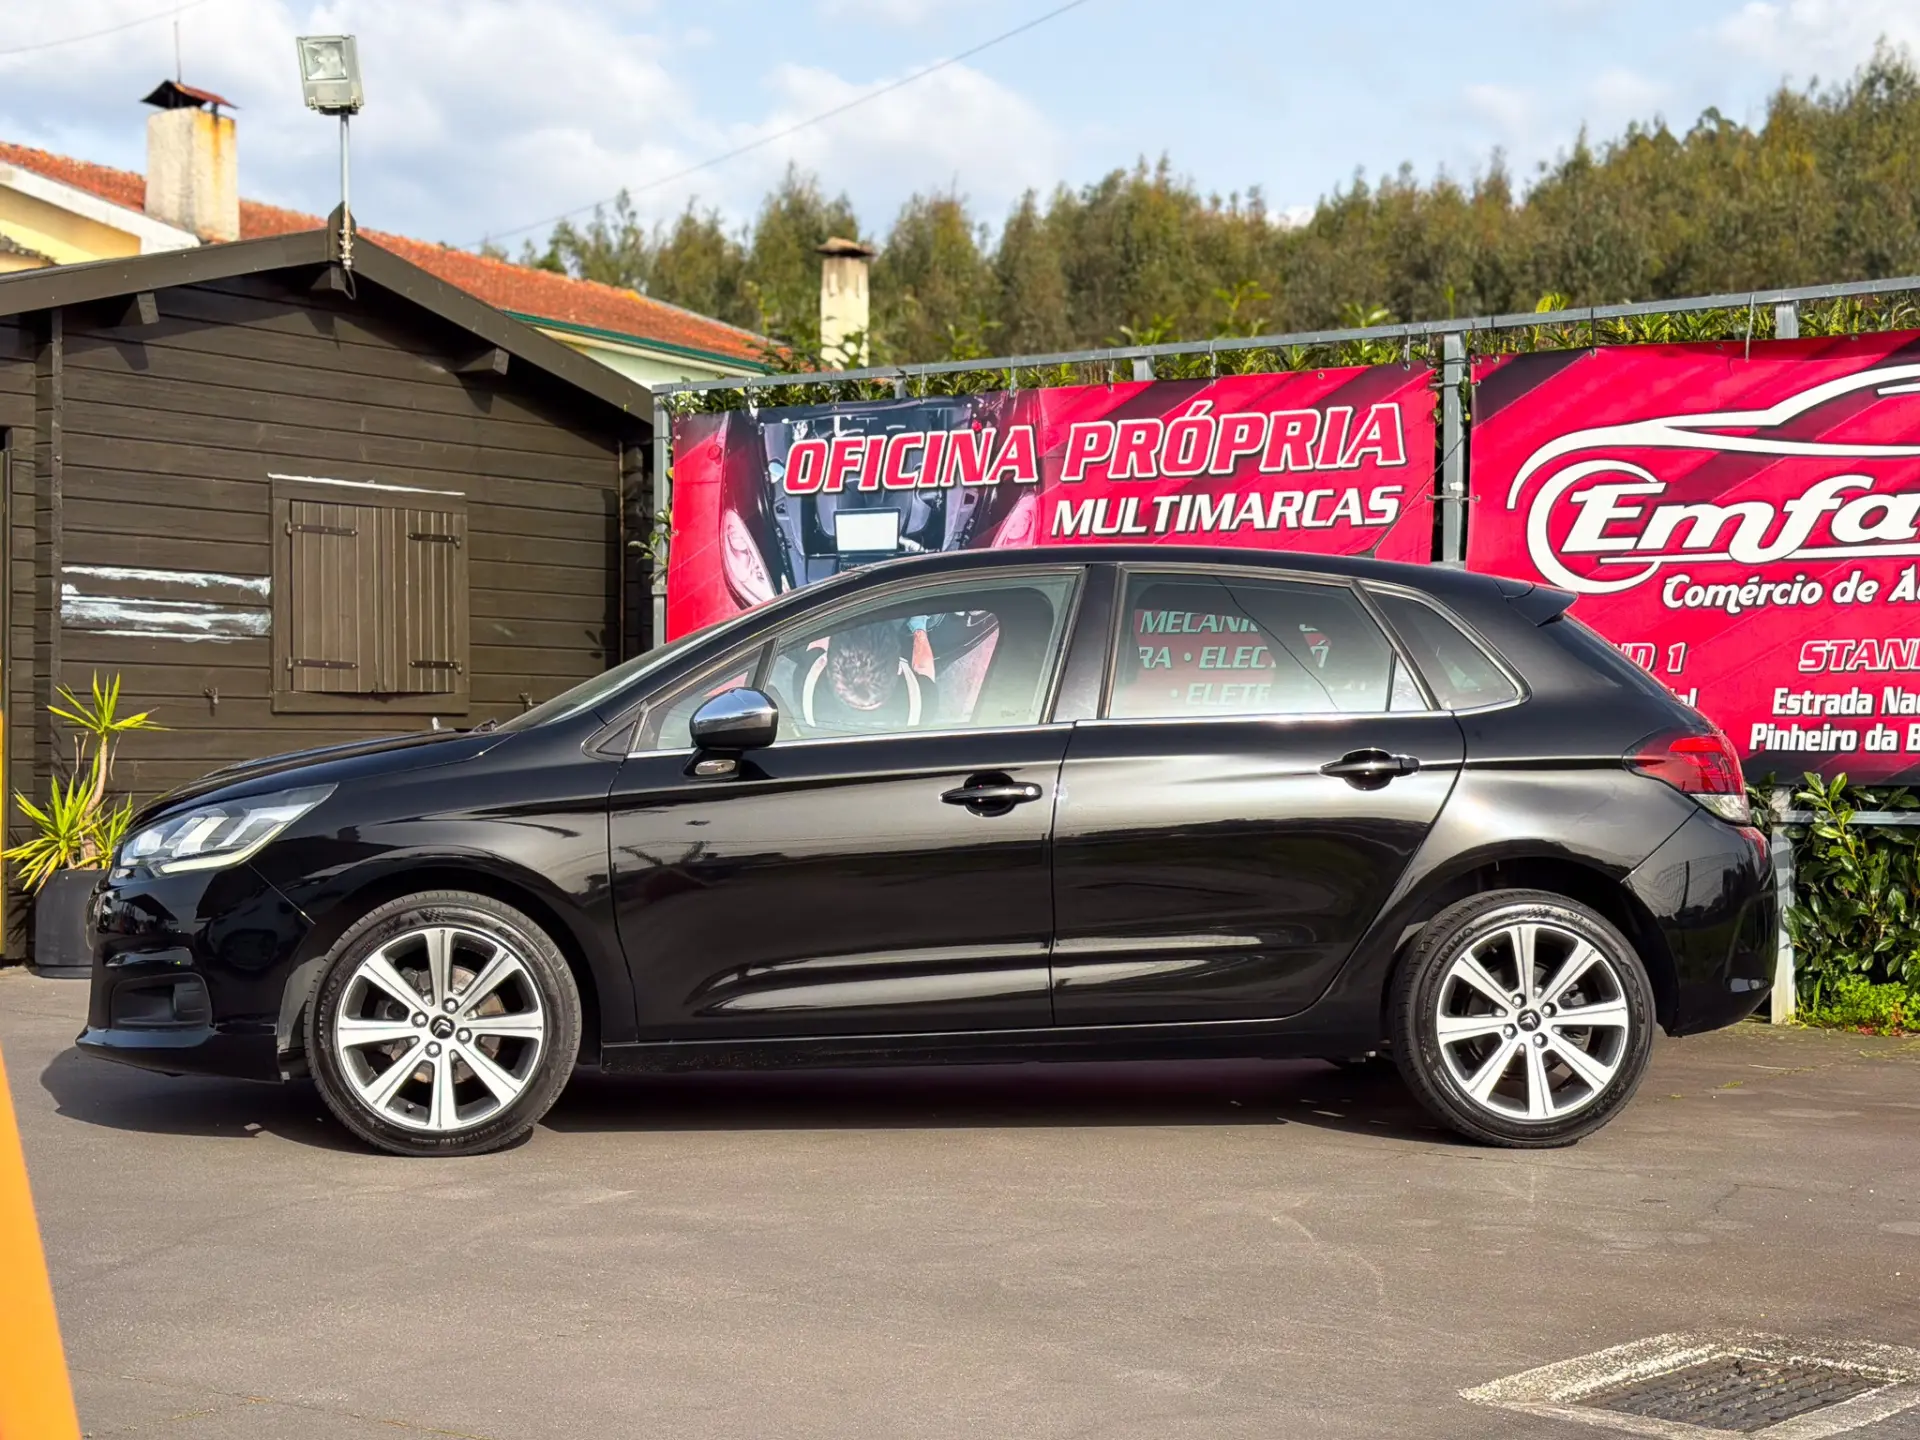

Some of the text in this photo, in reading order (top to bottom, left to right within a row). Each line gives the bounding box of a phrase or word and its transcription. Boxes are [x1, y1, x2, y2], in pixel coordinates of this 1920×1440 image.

[783, 400, 1406, 495] OFICINA PRÓPRIA
[1051, 485, 1403, 536] MULTIMARCAS
[1662, 574, 1823, 614] Comércio
[1832, 570, 1879, 604] de
[1667, 642, 1688, 674] 1
[1772, 686, 1873, 715] Estrada
[1749, 723, 1858, 752] Pinheiro
[1864, 723, 1898, 752] da
